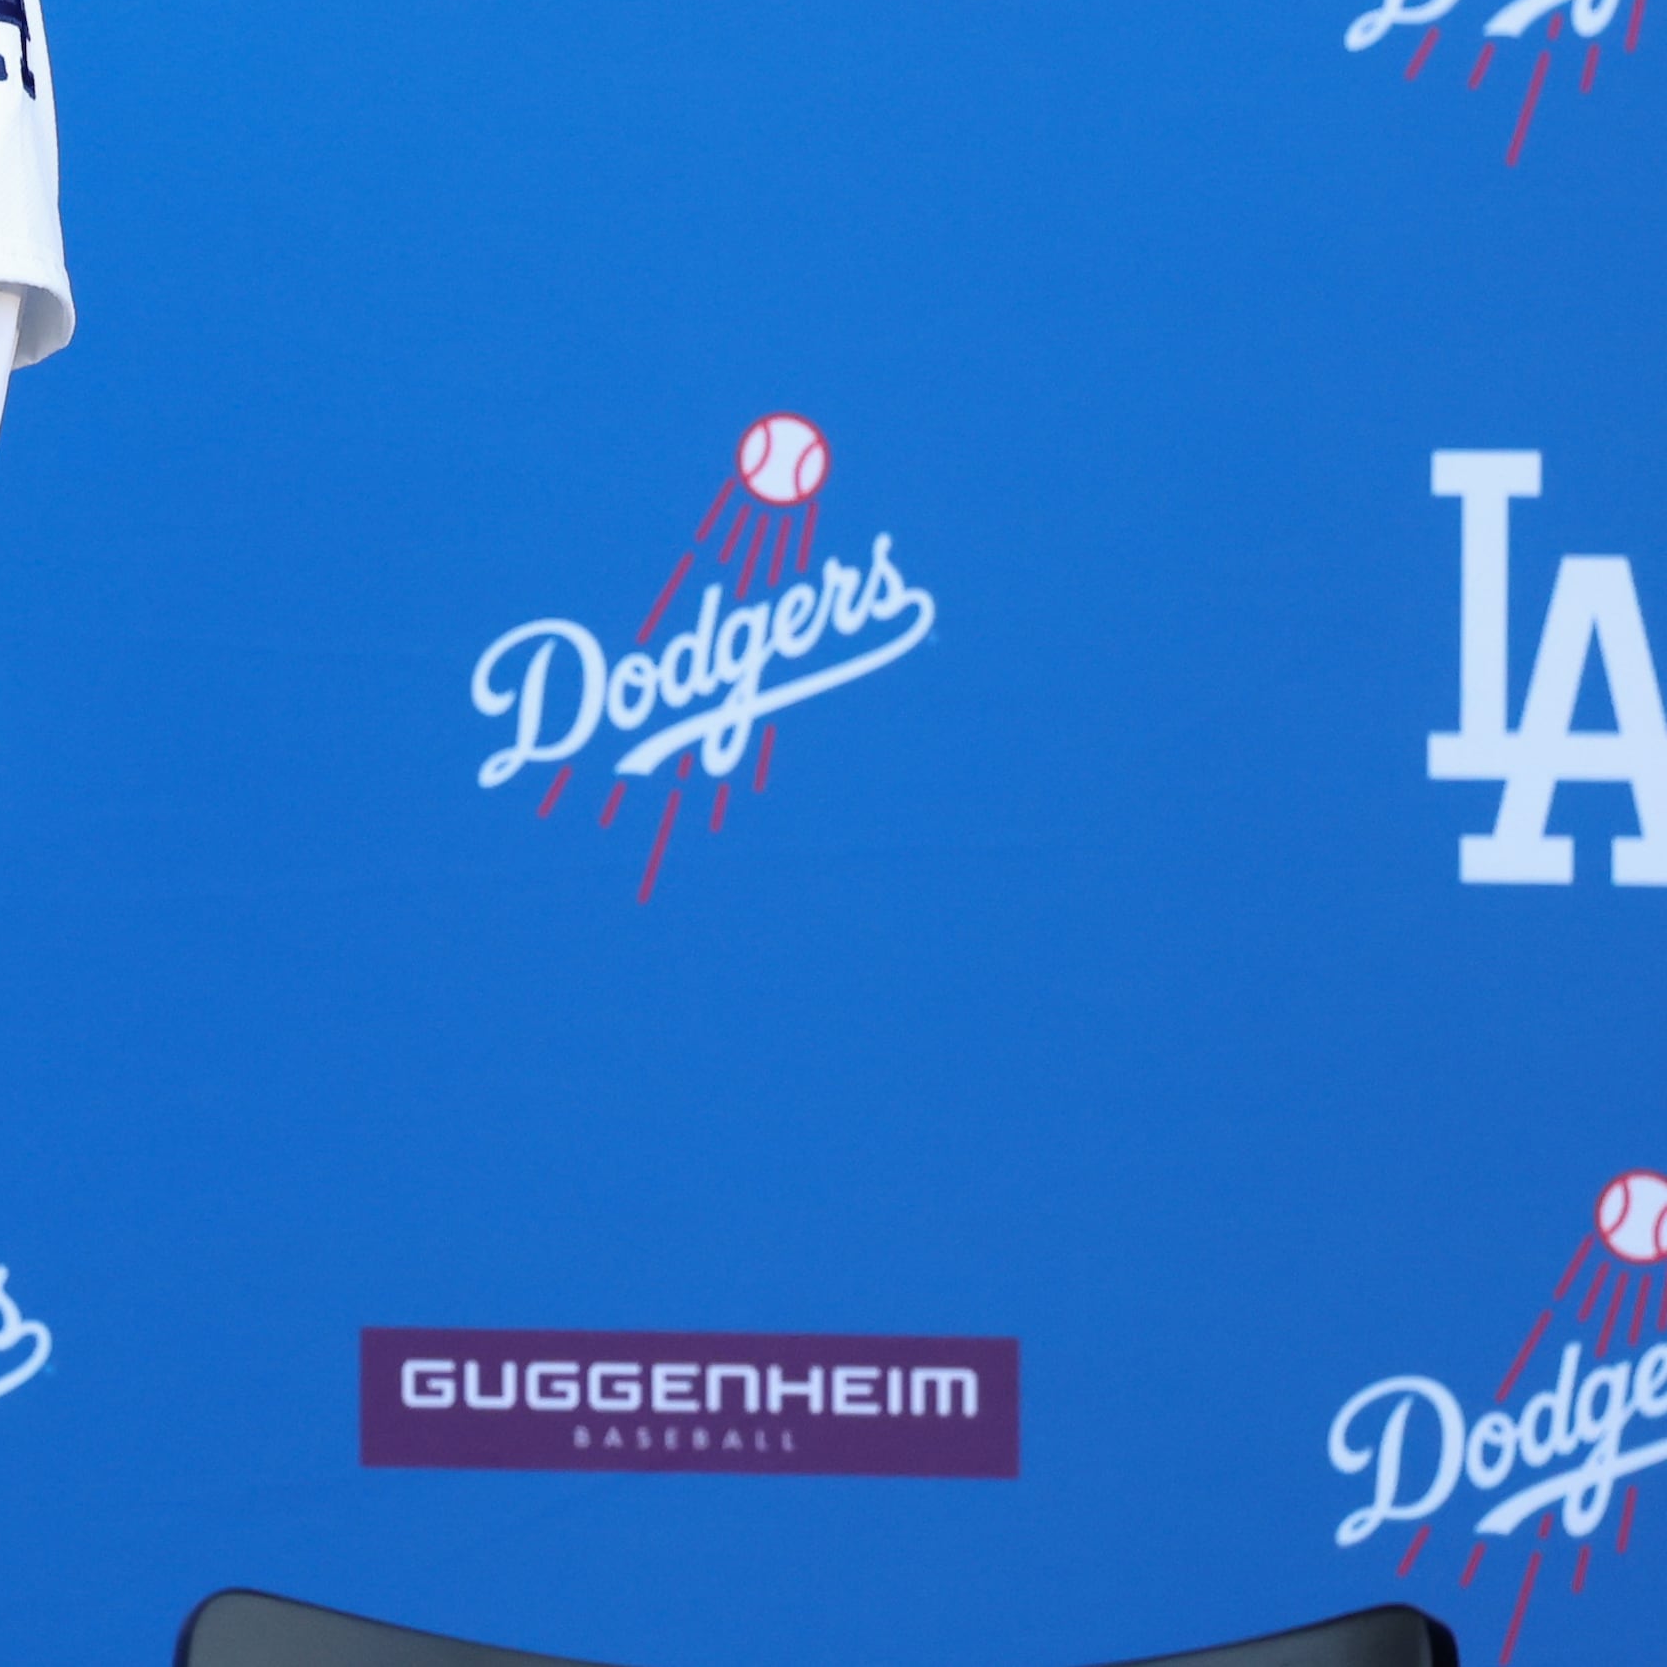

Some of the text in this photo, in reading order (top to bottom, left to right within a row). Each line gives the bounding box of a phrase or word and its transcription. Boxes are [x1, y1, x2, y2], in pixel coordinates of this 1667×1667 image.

[472, 534, 935, 787] Dodgers
[1427, 450, 1667, 886] LA
[401, 1359, 979, 1418] GUGGENHEIM
[574, 1427, 793, 1453] BASEBALL
[1330, 1341, 1667, 1545] Dodge
